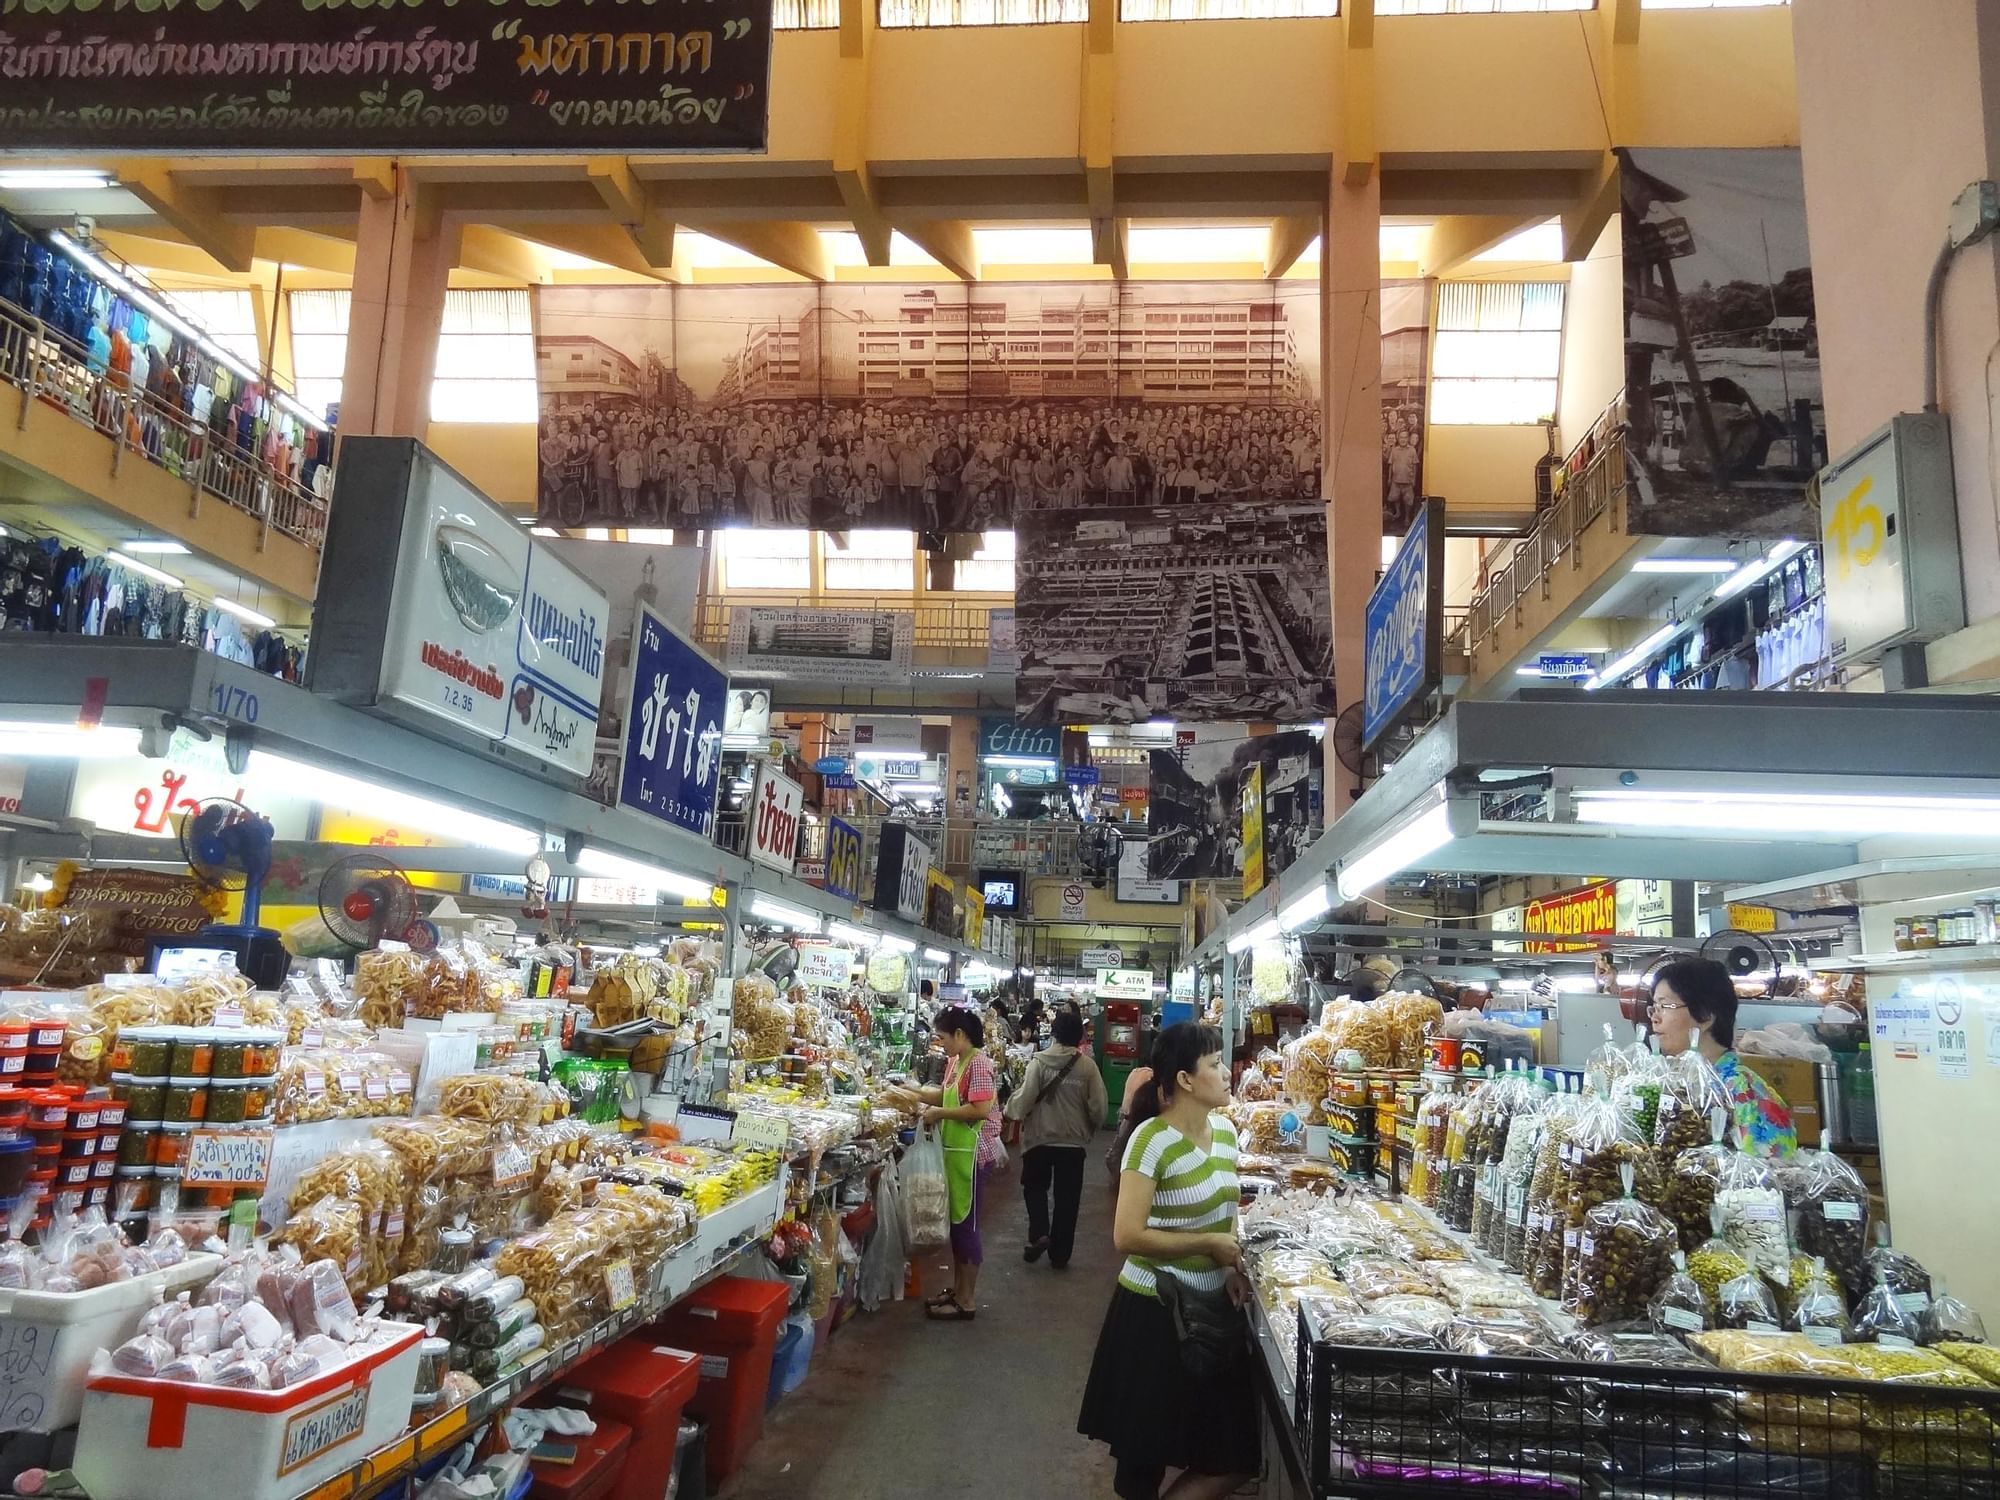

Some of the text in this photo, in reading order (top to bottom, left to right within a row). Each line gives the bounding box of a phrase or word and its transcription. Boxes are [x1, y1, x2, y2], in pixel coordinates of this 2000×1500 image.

[1826, 474, 1884, 581] 15
[645, 622, 659, 652] ร้าน
[214, 683, 259, 723] 1/70
